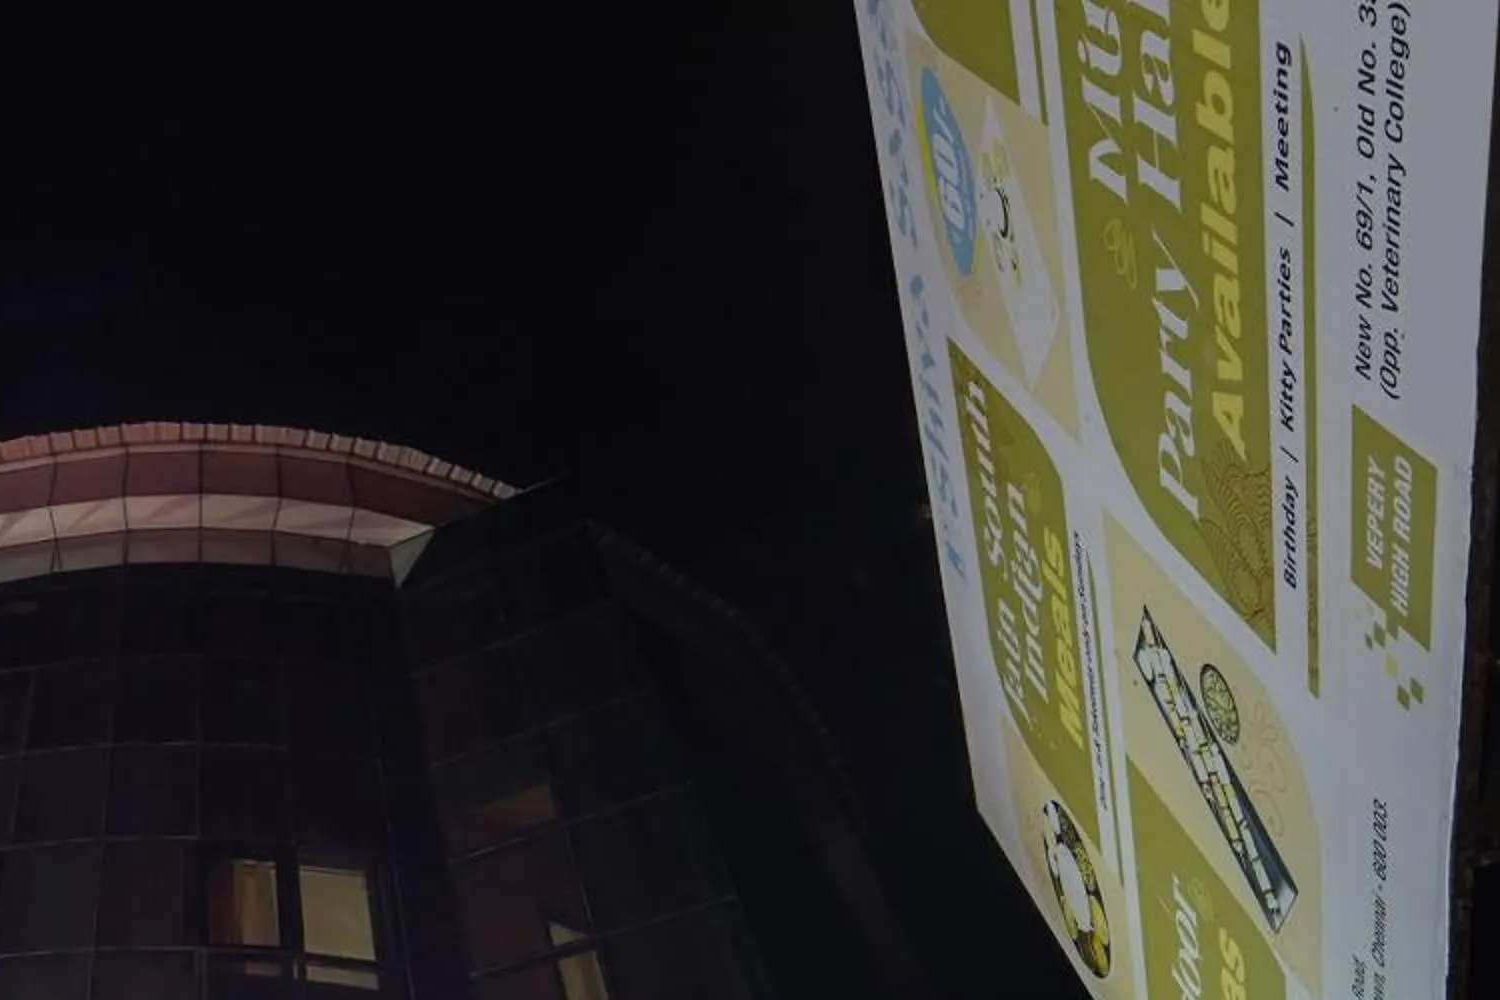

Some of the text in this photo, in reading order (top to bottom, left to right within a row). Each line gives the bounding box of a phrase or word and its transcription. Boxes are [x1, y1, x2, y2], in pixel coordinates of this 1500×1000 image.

[1272, 40, 1293, 191] Meeting
[1353, 0, 1378, 380] New No. 69/1, Old No. 3
[1193, 0, 1248, 460] Available
[1380, 0, 1411, 399] (Opp. Veterinary College)
[1151, 227, 1200, 517] Party
[1275, 246, 1294, 355] Parties
[1277, 360, 1297, 431] Kitty
[1279, 474, 1300, 589] Birthday
[1366, 452, 1384, 571] VEPERY
[1389, 452, 1413, 616] HIGH ROAD
[1041, 524, 1084, 748] Meals
[1371, 895, 1386, 966] Chennai
